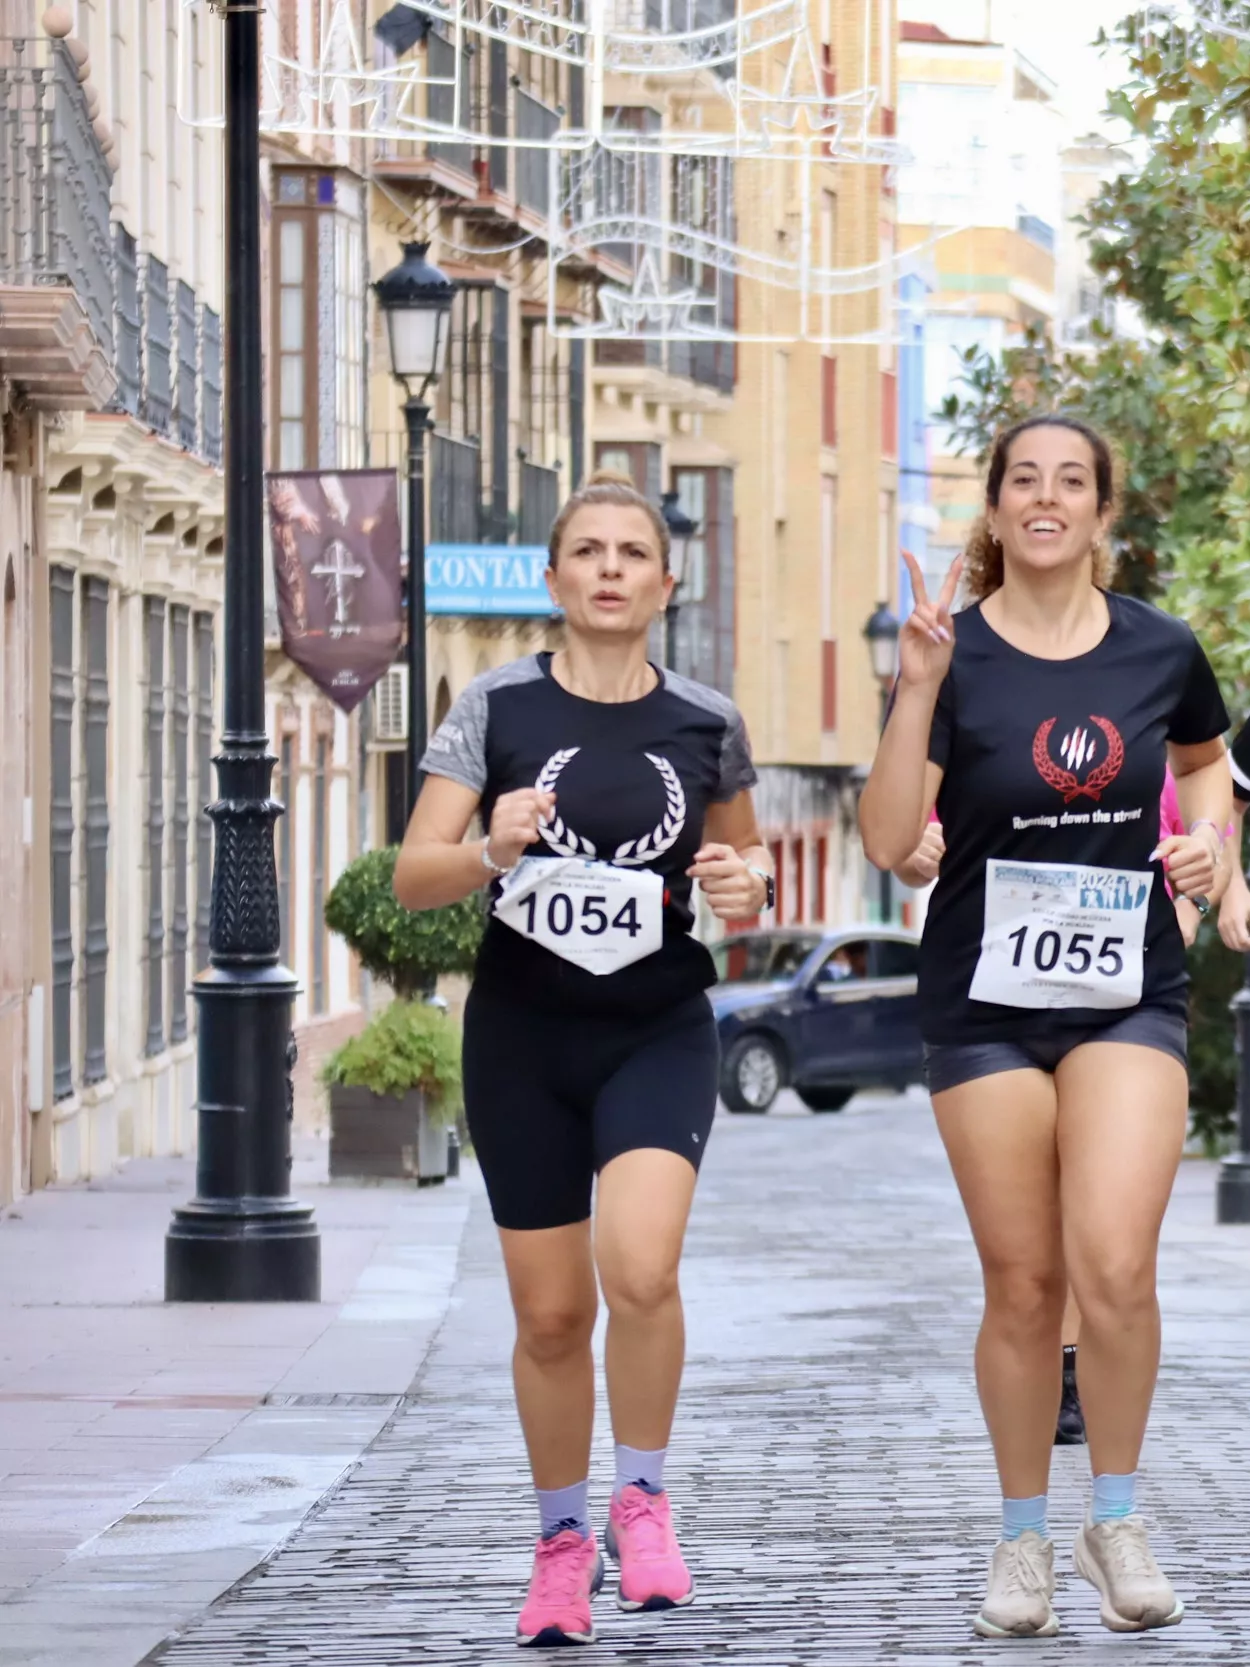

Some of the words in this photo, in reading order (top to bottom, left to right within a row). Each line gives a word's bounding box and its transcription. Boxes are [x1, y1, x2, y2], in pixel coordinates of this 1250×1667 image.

[1012, 816, 1058, 829] Running
[1060, 811, 1090, 825] down
[1092, 808, 1111, 823] the
[1080, 873, 1118, 889] 2024
[518, 891, 642, 938] 1054
[1008, 925, 1124, 977] 1055
